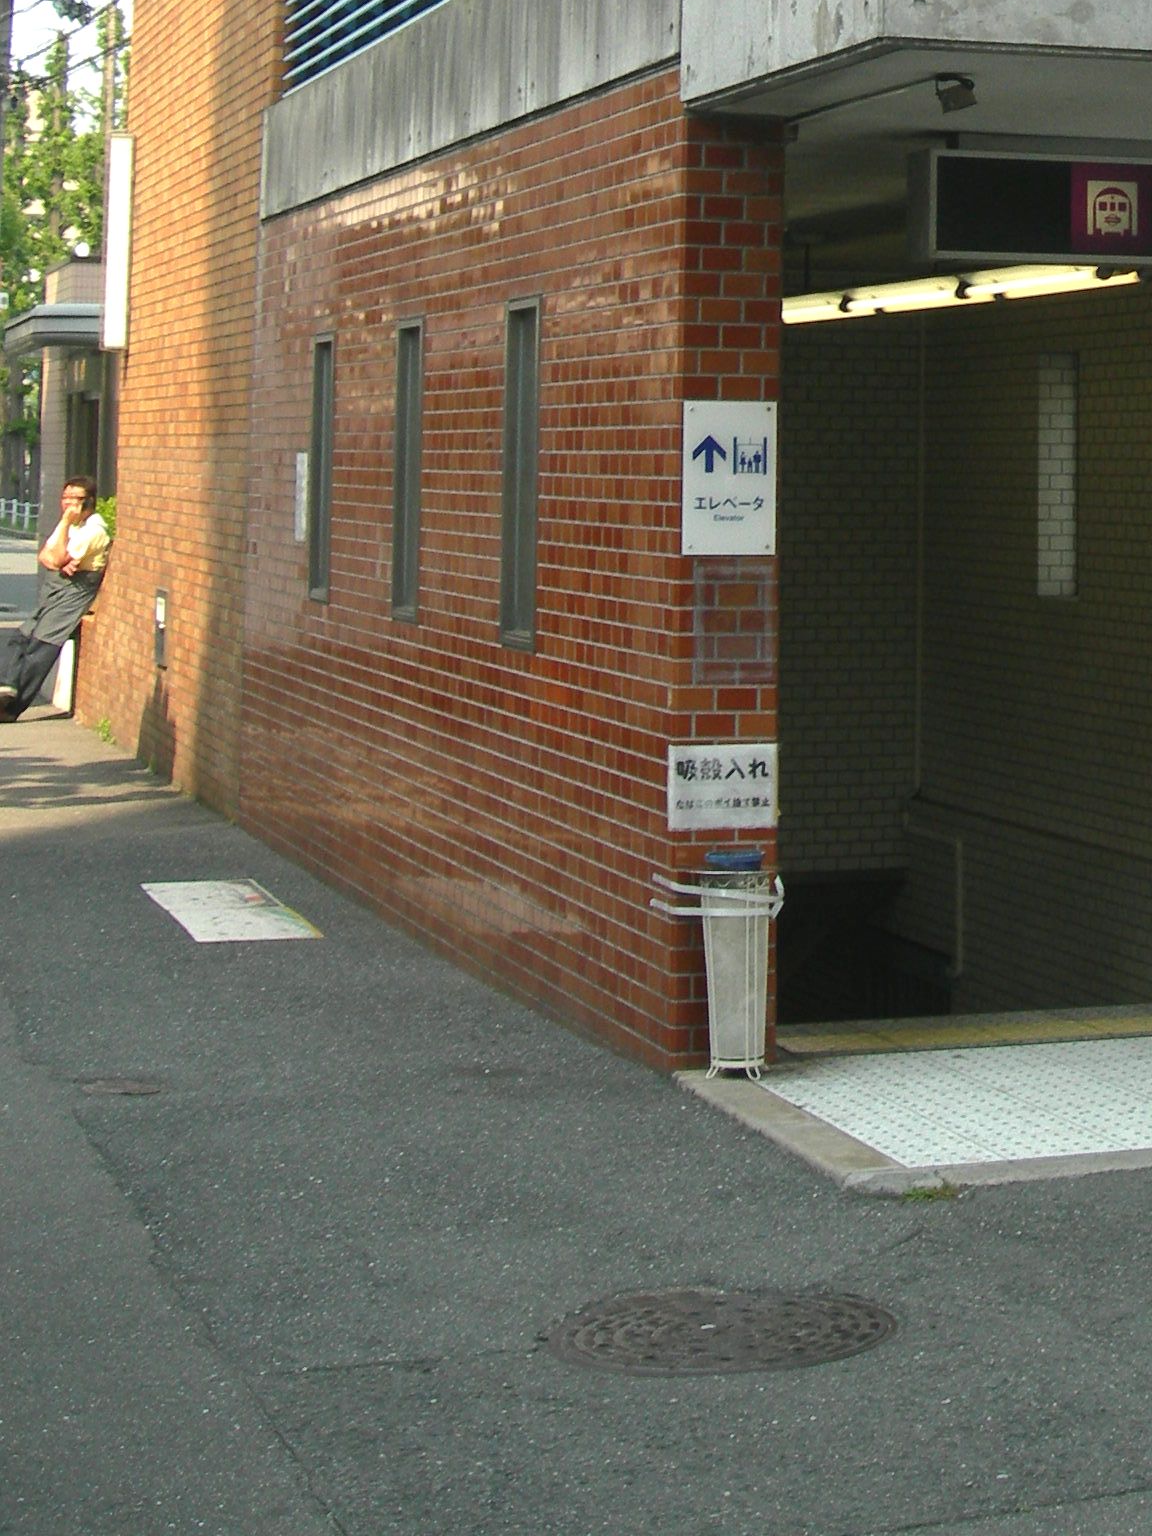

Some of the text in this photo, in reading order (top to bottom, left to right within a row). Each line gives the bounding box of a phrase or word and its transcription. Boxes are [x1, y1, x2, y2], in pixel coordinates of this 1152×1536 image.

[693, 495, 766, 512] エレベータ
[713, 514, 745, 522] Elevator
[675, 757, 770, 782] 吸殻入れ
